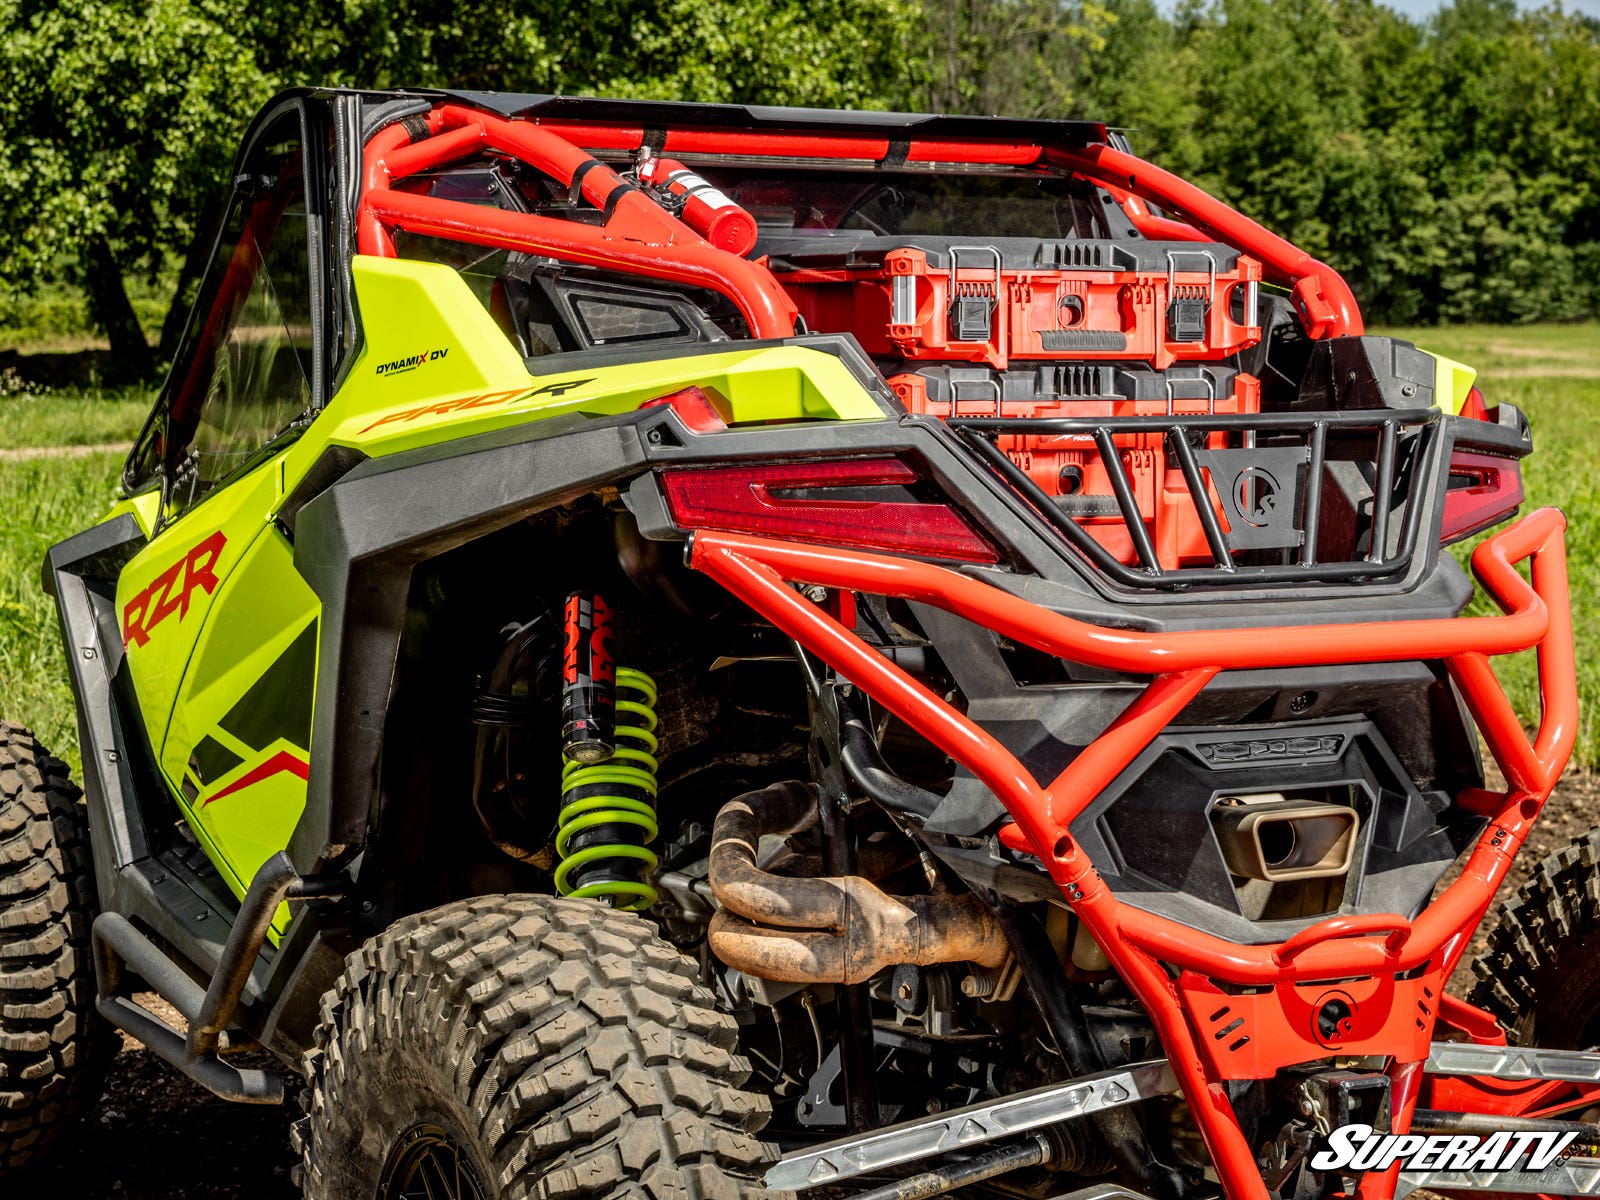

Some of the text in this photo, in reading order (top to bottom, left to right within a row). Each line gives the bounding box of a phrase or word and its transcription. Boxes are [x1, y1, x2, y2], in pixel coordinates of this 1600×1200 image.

[376, 350, 428, 375] DYNAMIX
[430, 348, 448, 361] DV
[356, 386, 535, 435] PRO
[123, 529, 228, 649] RZR
